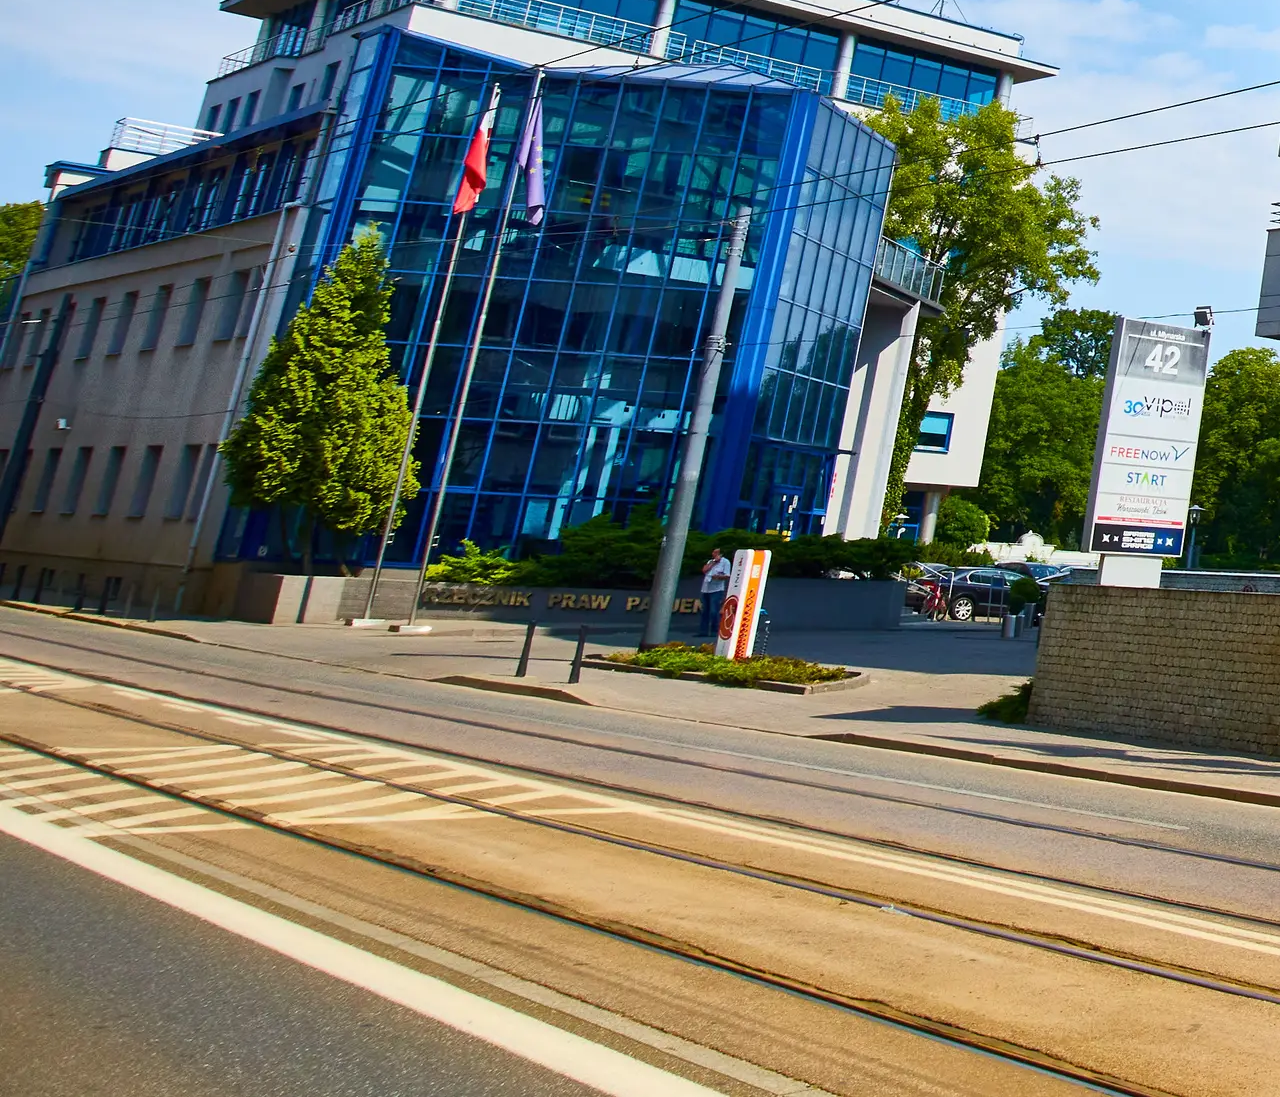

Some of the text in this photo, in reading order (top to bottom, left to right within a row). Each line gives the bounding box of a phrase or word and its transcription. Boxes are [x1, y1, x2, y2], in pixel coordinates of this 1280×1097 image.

[1144, 343, 1181, 375] 42
[1126, 471, 1168, 487] START
[421, 587, 533, 607] RZECZNIK
[548, 594, 612, 610] PRAW
